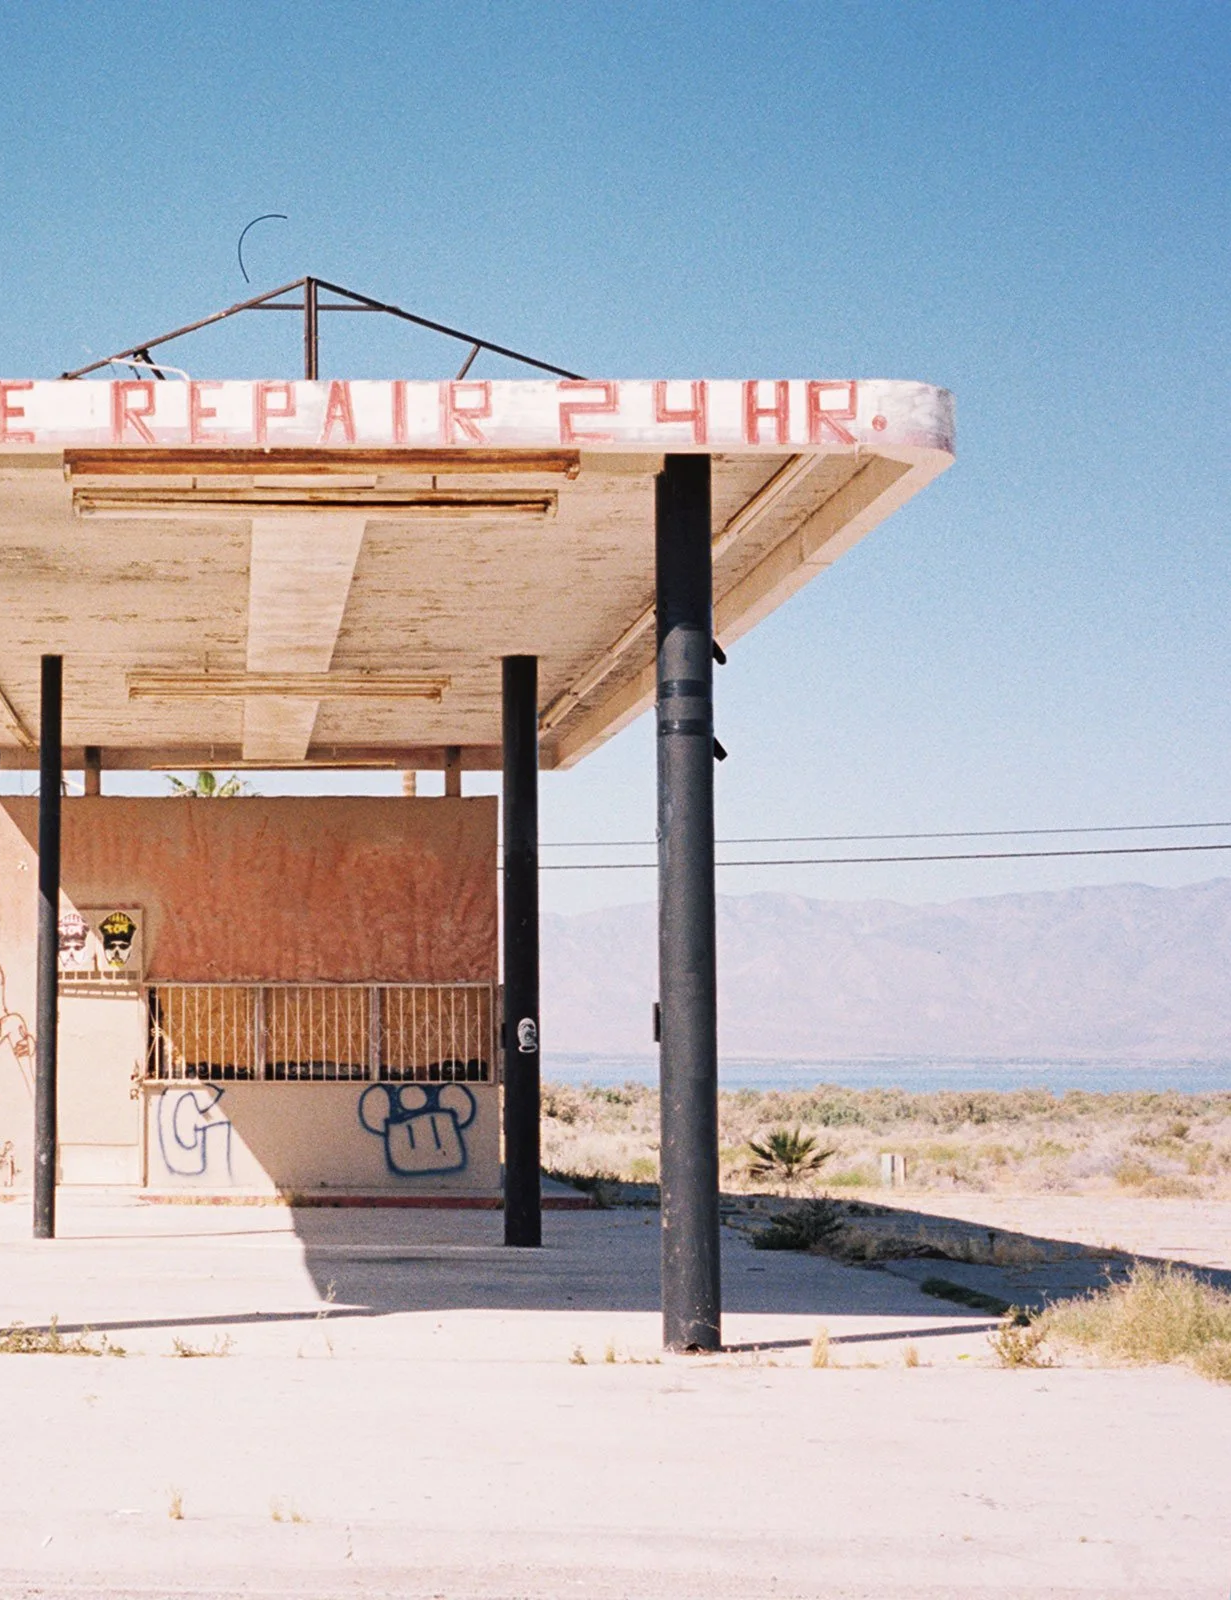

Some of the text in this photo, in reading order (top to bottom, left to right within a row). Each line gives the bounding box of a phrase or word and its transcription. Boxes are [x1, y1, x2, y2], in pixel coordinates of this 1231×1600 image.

[110, 379, 492, 445] REPAIR
[557, 379, 709, 445] 24
[740, 379, 887, 446] HR.
